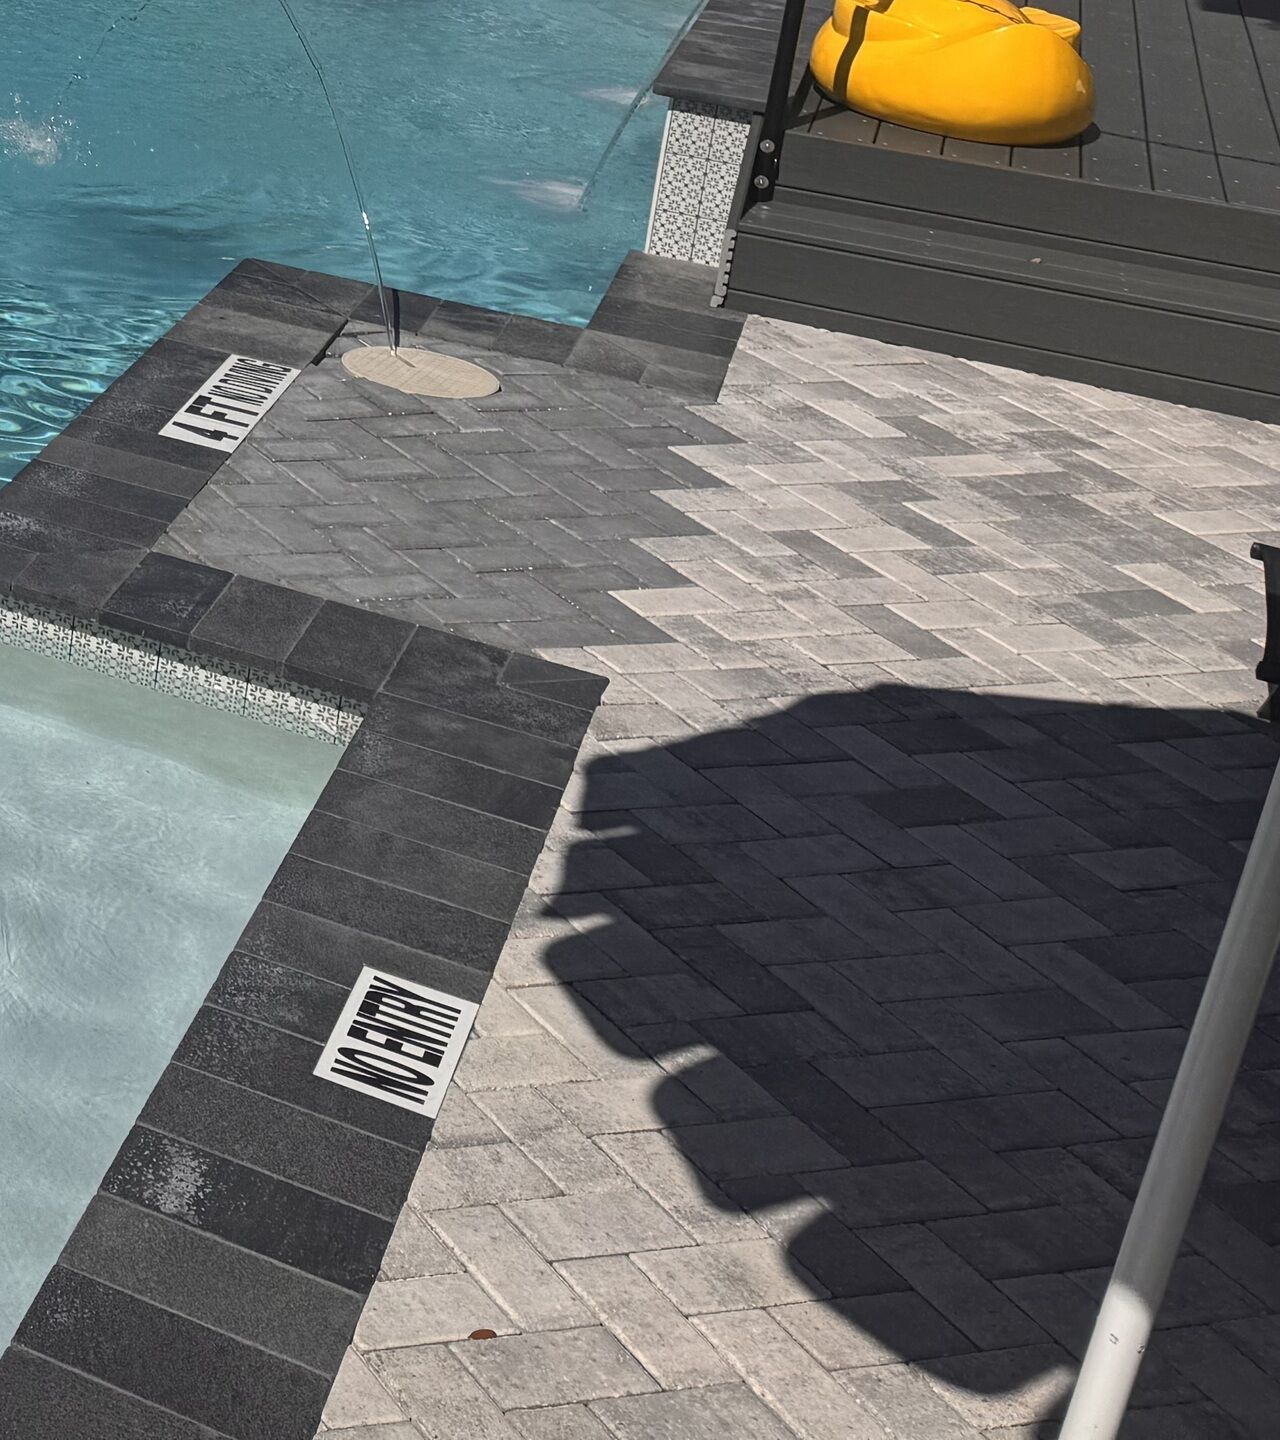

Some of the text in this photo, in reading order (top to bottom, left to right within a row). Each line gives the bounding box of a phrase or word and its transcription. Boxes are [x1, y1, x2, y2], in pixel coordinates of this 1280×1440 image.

[171, 358, 292, 441] 4 FT NO DIVING
[330, 975, 461, 1105] NO ENTRY
